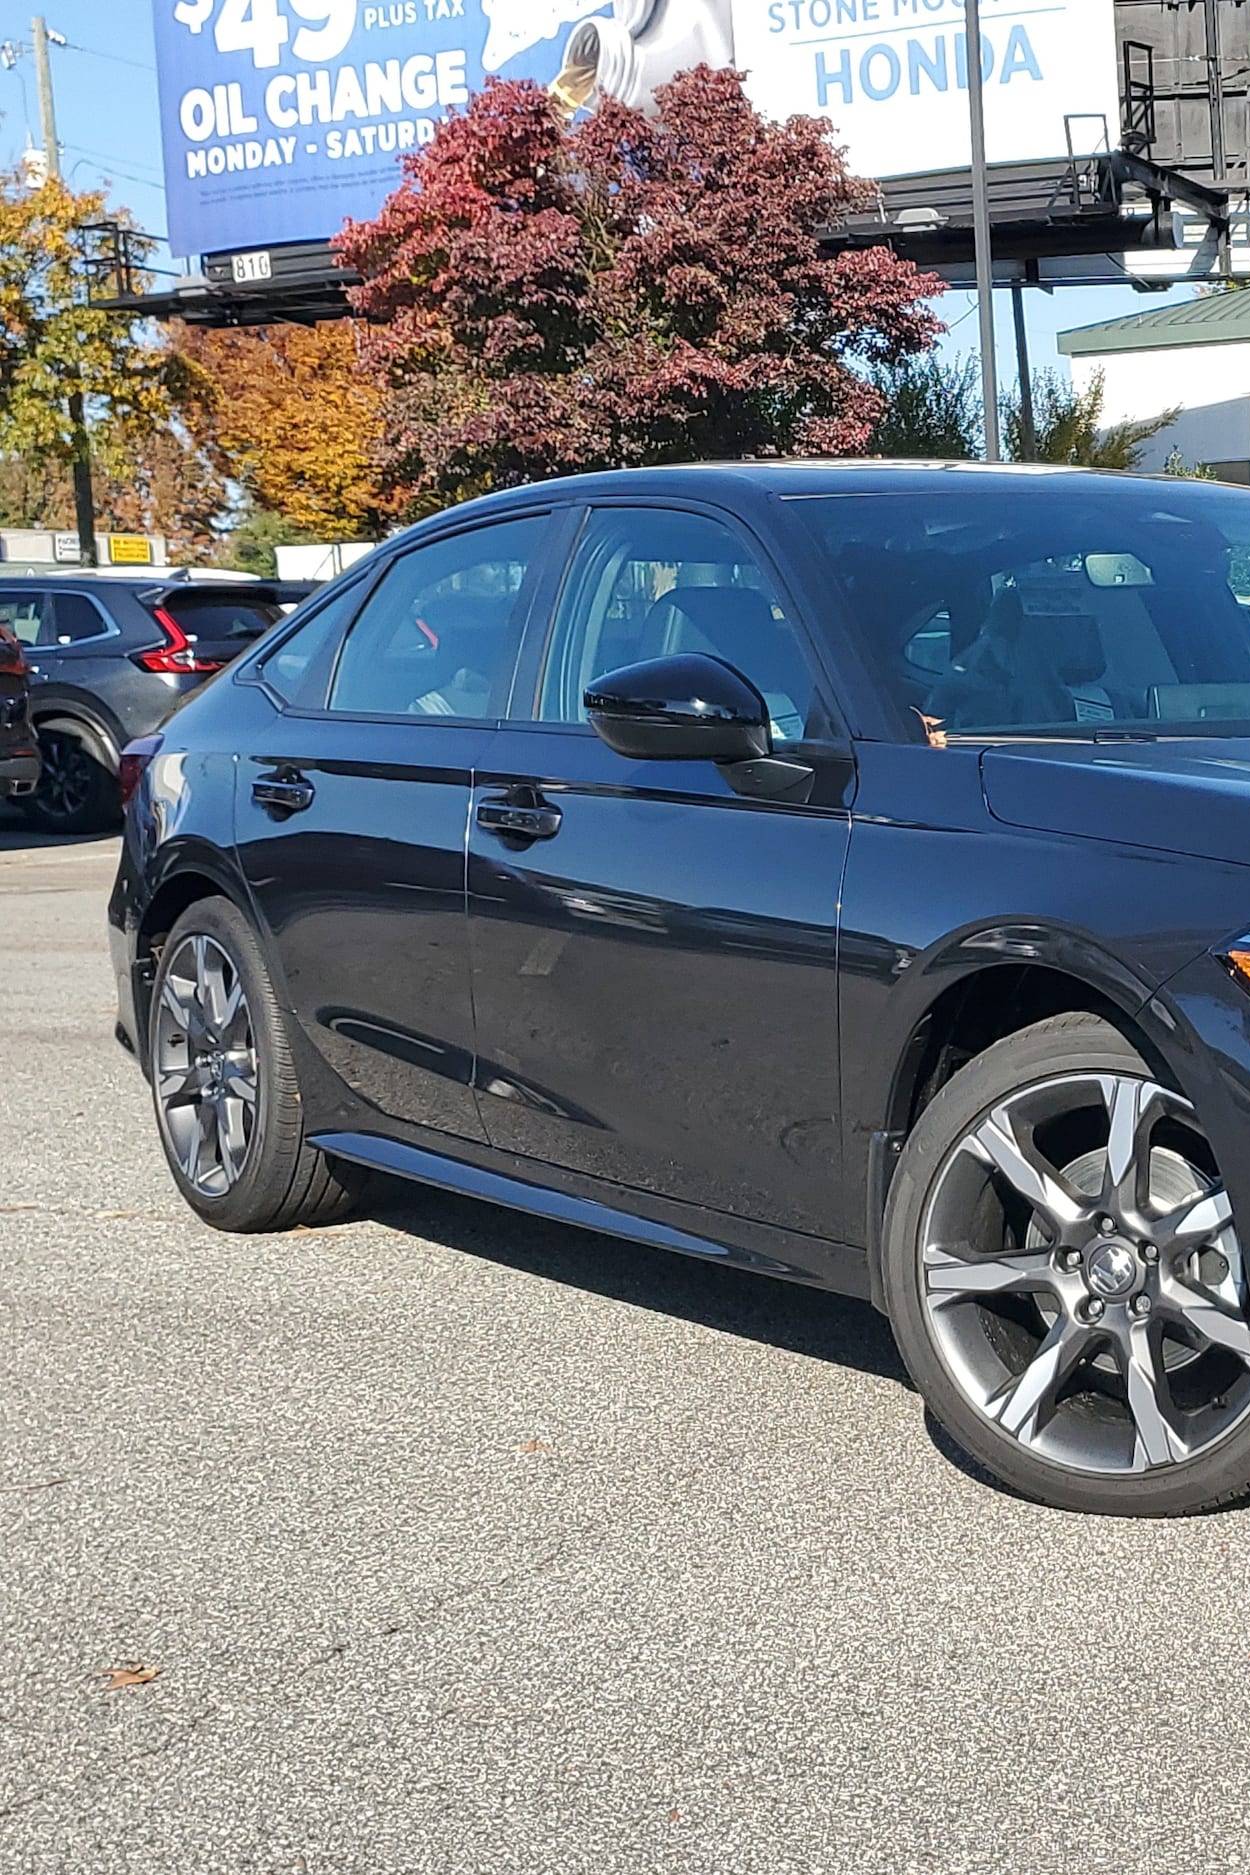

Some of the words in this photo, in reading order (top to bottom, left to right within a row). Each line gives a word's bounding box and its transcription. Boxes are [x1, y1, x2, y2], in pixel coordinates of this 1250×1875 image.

[364, 1, 417, 30] PLUS
[423, 0, 465, 21] TAX
[768, 0, 880, 33] STONE
[815, 24, 1043, 107] HONDA
[180, 82, 258, 142] OIL
[264, 49, 469, 129] CHANGE
[186, 136, 297, 179] MONDAY
[326, 116, 449, 160] SATURD
[236, 256, 269, 279] 810
